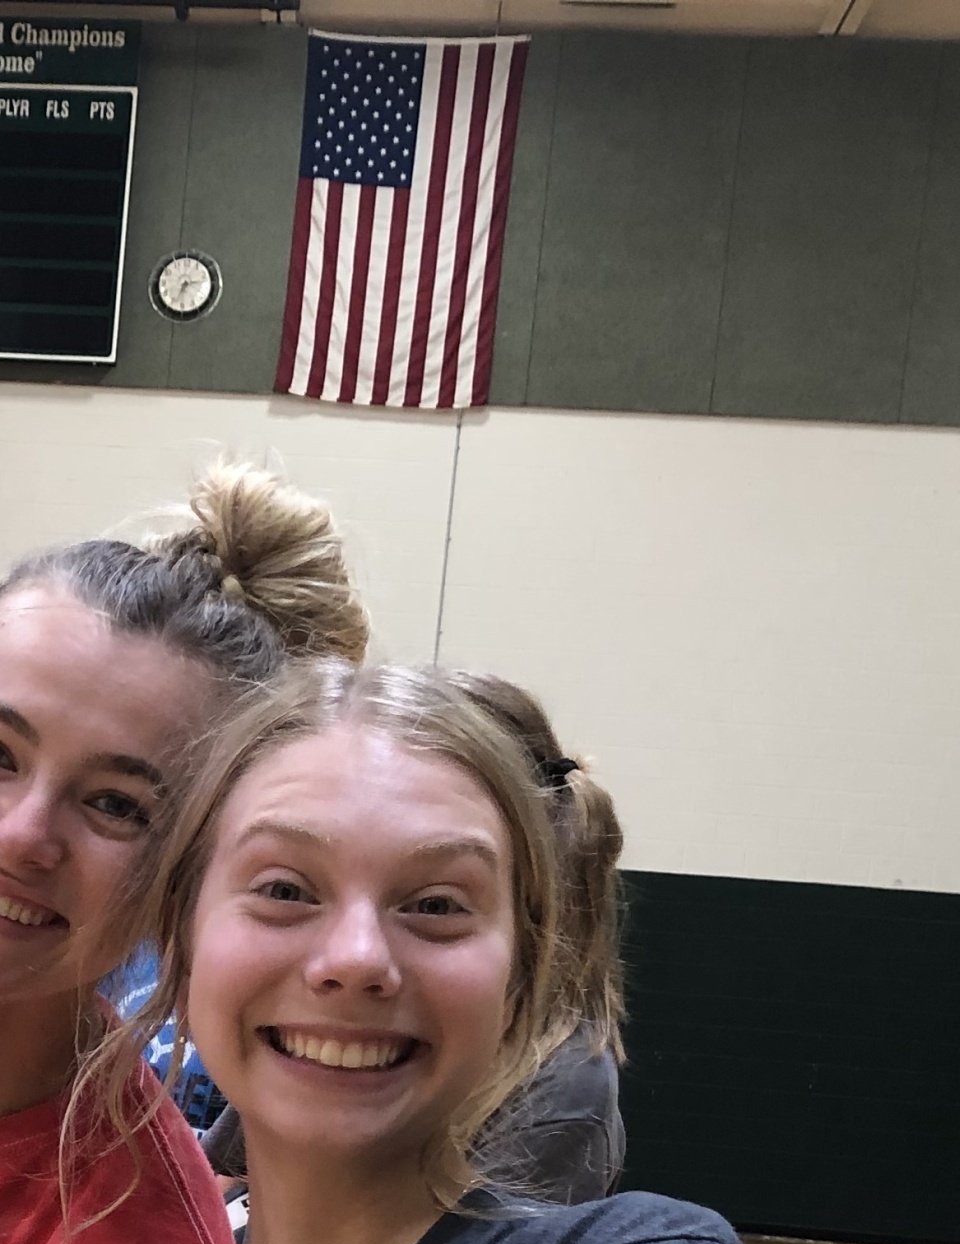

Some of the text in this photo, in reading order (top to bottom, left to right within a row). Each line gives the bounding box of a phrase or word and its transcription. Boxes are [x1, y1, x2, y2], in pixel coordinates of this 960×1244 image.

[10, 22, 126, 52] Champions
[45, 99, 70, 119] FLS
[89, 101, 115, 120] PTS
